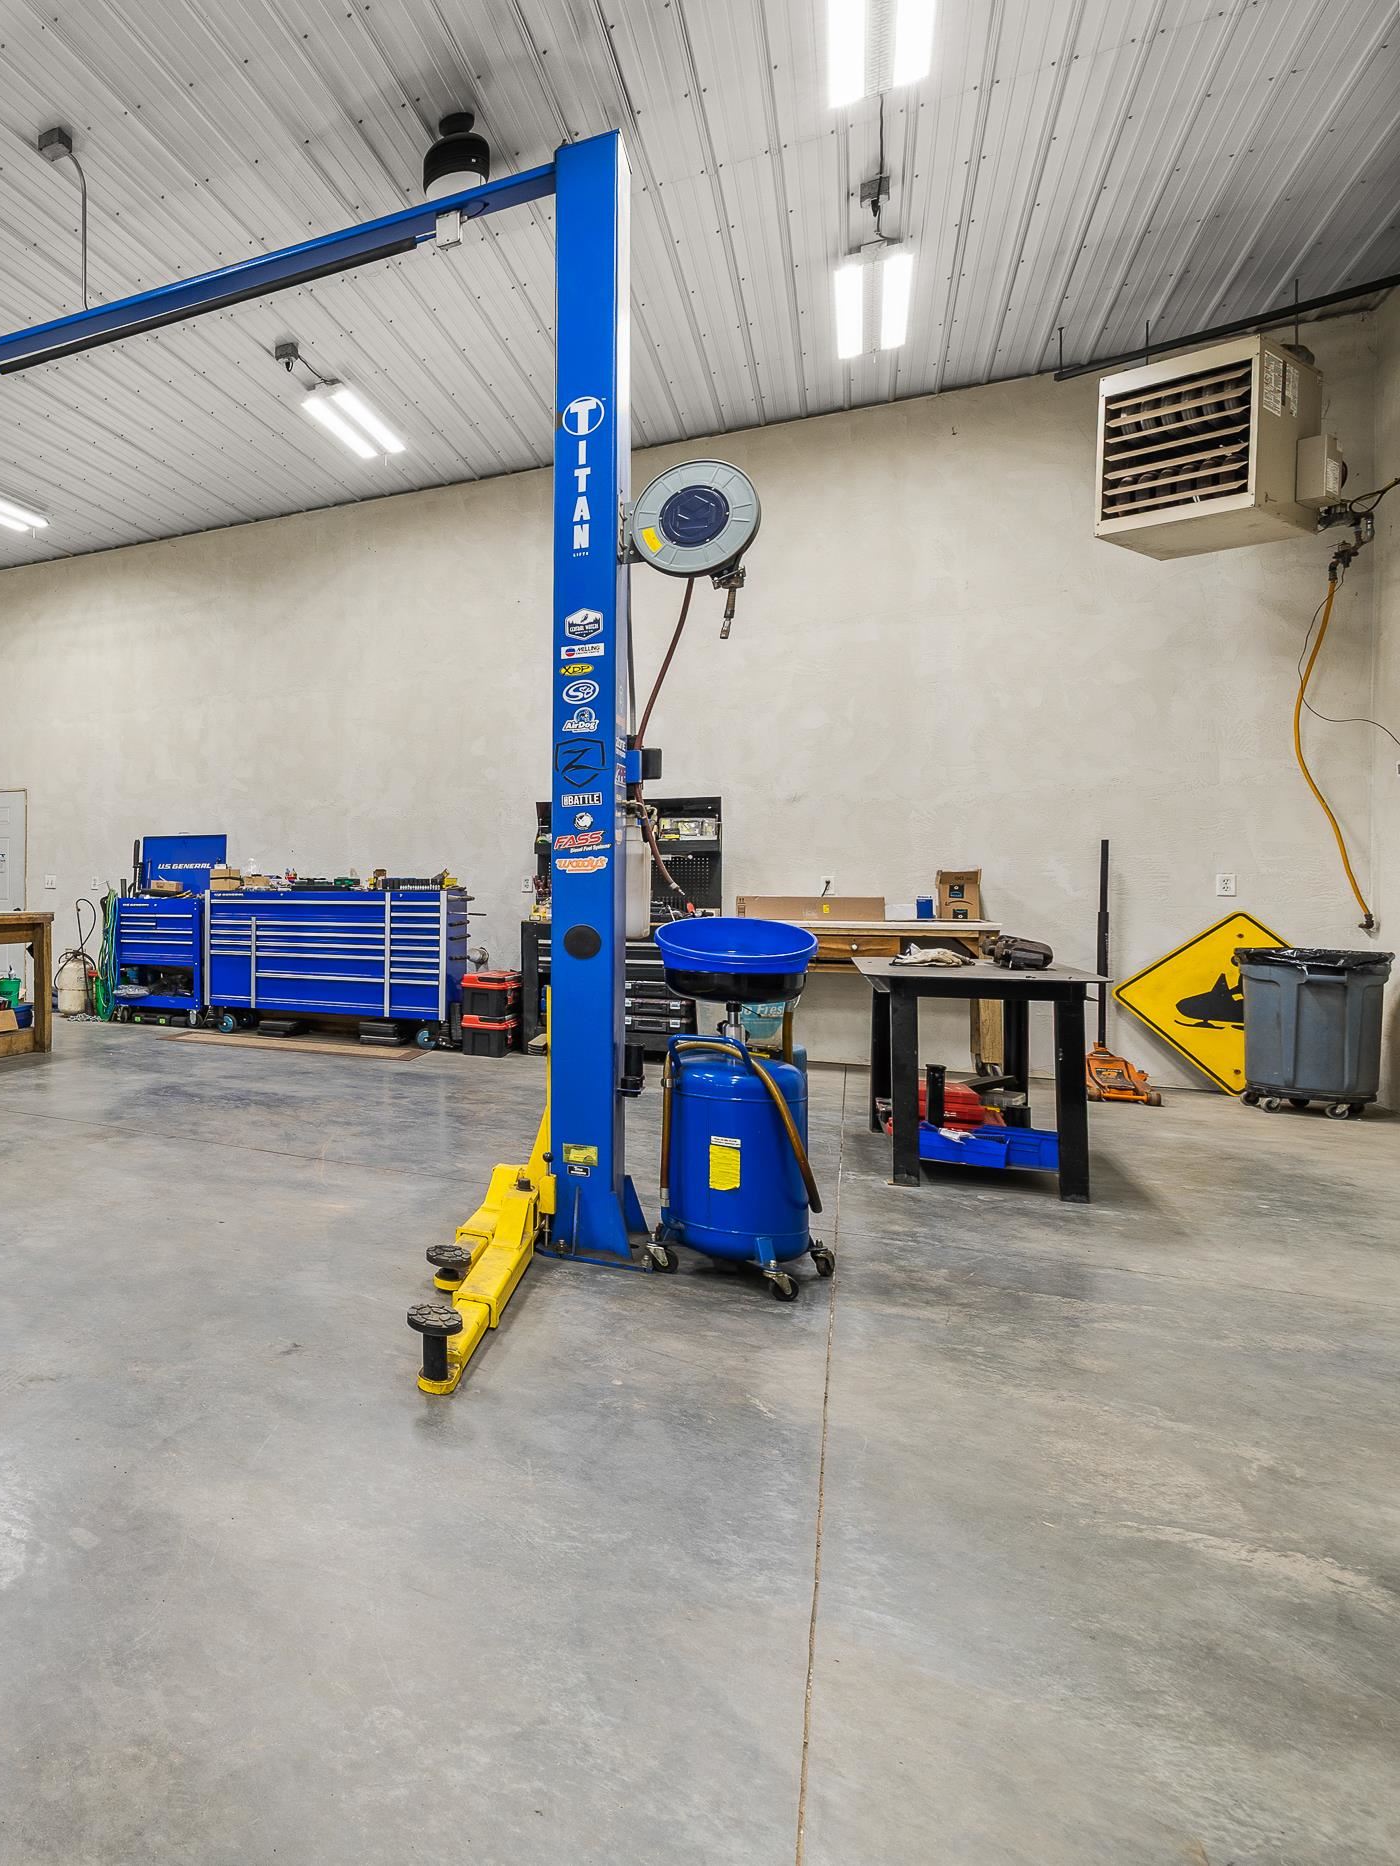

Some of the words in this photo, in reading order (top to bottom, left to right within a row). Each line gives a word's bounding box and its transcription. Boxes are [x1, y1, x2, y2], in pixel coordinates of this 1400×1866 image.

[569, 398, 597, 550] TITAN
[562, 665, 590, 678] XDP
[565, 720, 598, 731] AirDog
[554, 830, 604, 850] FASS
[172, 862, 212, 870] GENERAL
